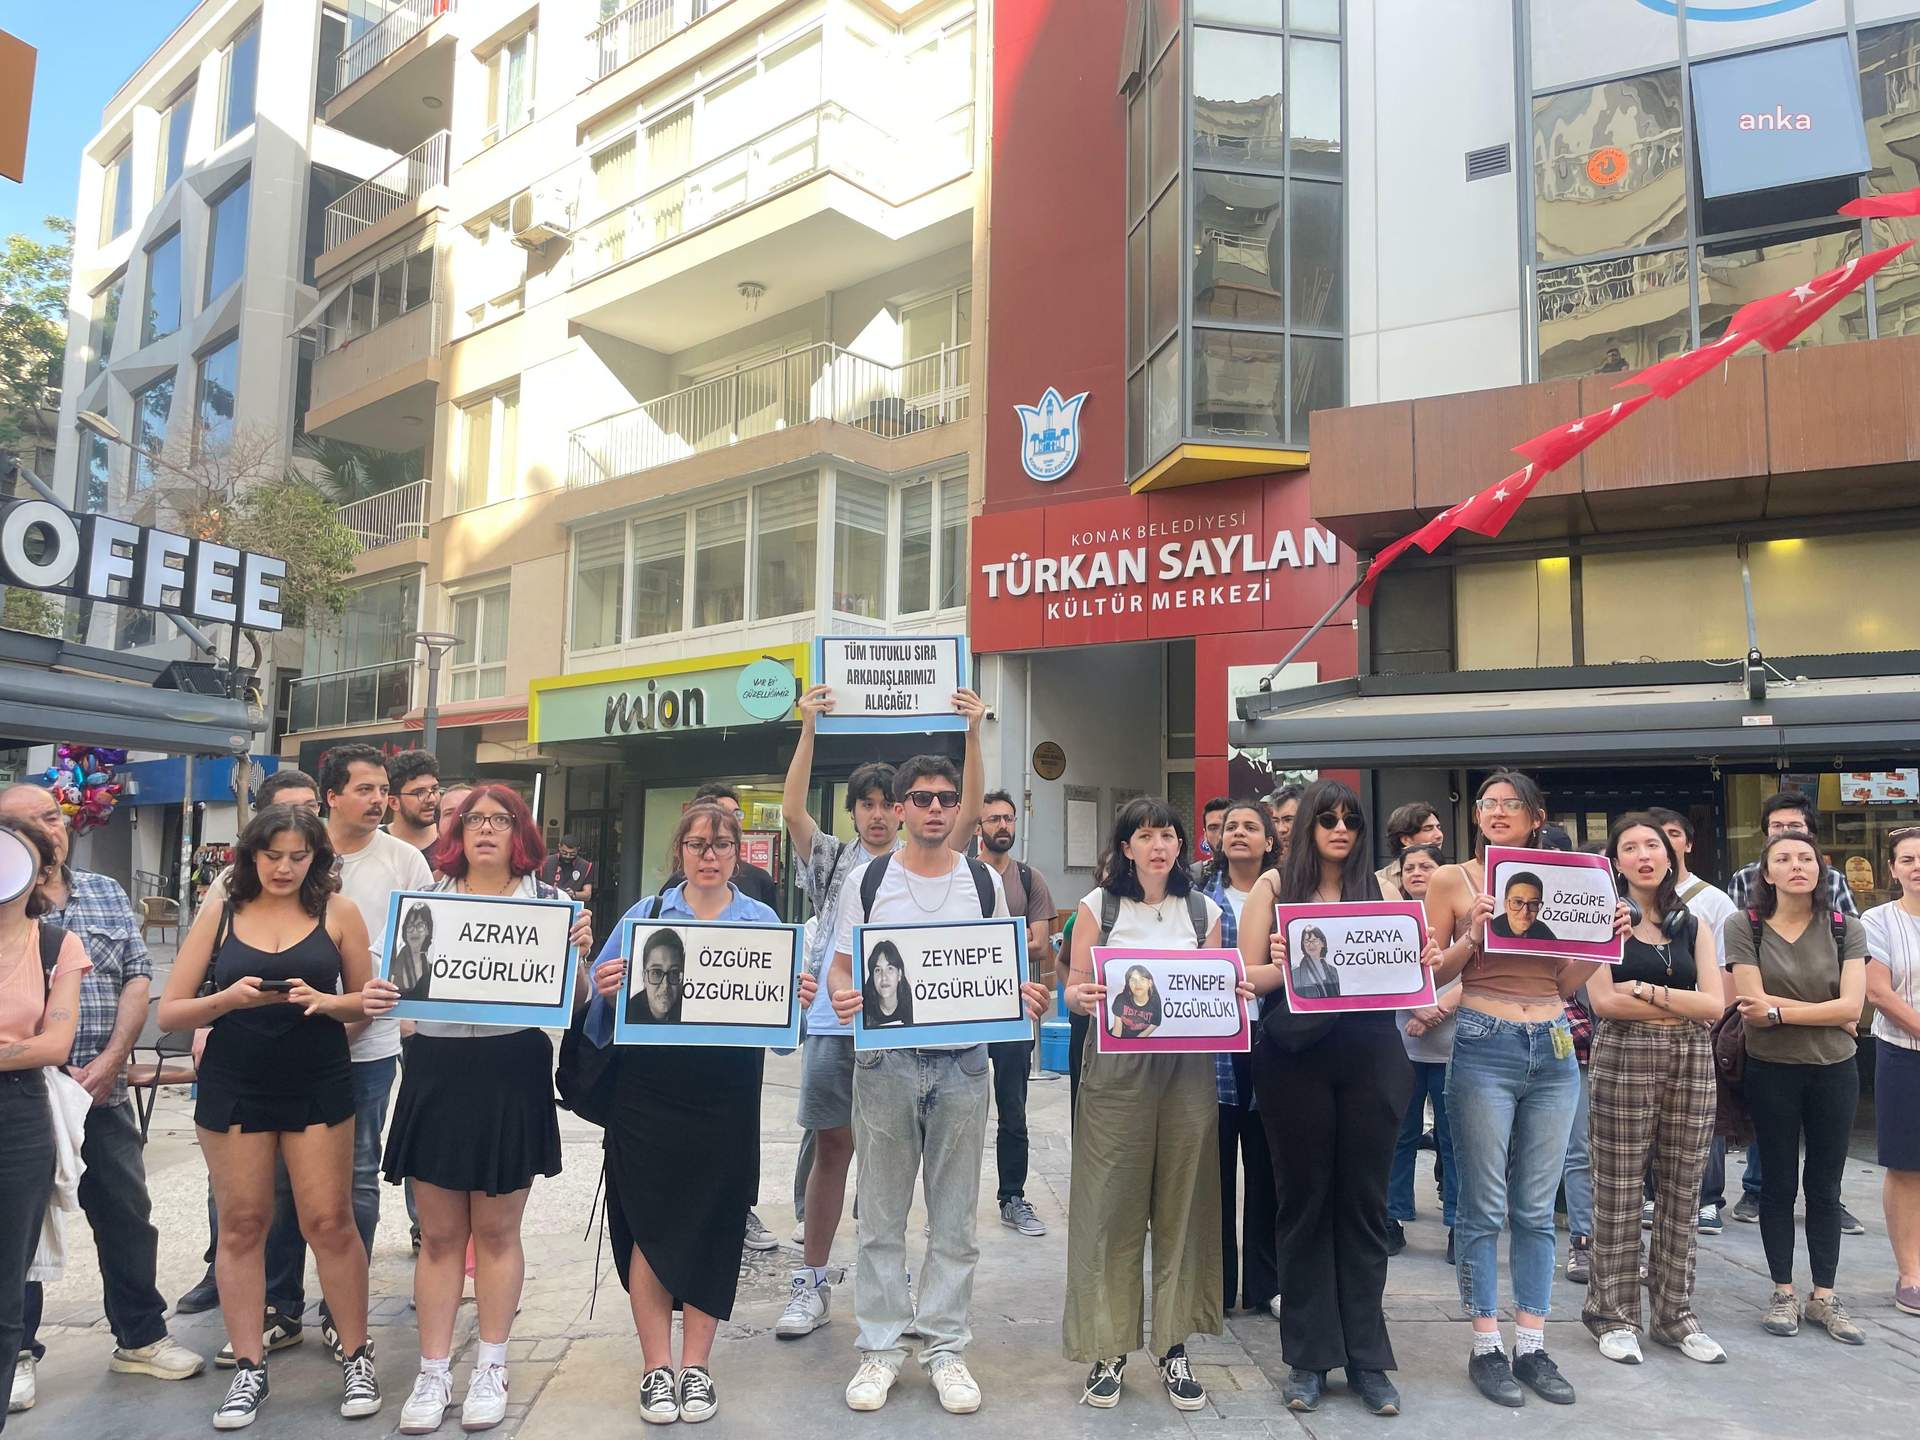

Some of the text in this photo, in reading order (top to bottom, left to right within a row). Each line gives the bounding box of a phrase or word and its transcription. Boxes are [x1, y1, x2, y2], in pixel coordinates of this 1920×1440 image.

[1739, 104, 1811, 130] anka
[1071, 511, 1247, 547] KONAK BELEDİYESİ
[981, 527, 1338, 598] TÜRKAN SAYLAN
[1047, 578, 1271, 620] KÜLTÜR MERKEZİ
[844, 642, 937, 661] TÜM TUTUKLU SIRA
[847, 668, 936, 691] ARKADAŞLARIMIZI
[604, 679, 706, 735] mion
[865, 690, 912, 711] ALACAĞIZ
[1552, 889, 1606, 907] ÖZGÜR'E
[1542, 906, 1611, 925] ÖZGÜRLÜK!
[458, 922, 539, 946] AZRAYA
[1344, 928, 1403, 945] AZRA'YA
[699, 946, 773, 969] ÖZGÜRE
[921, 946, 1003, 968] ZEYNEP'E
[1333, 947, 1417, 966] ÖZGÜRLÜK!
[433, 954, 555, 984] ÖZGÜRLÜK!
[683, 978, 784, 1003] ÖZGÜRLÜK!
[914, 975, 1014, 1001] ÖZGÜRLÜK!
[1168, 974, 1225, 991] ZEYNEP'E
[1163, 997, 1236, 1019] ÖZGÜRLÜK!
